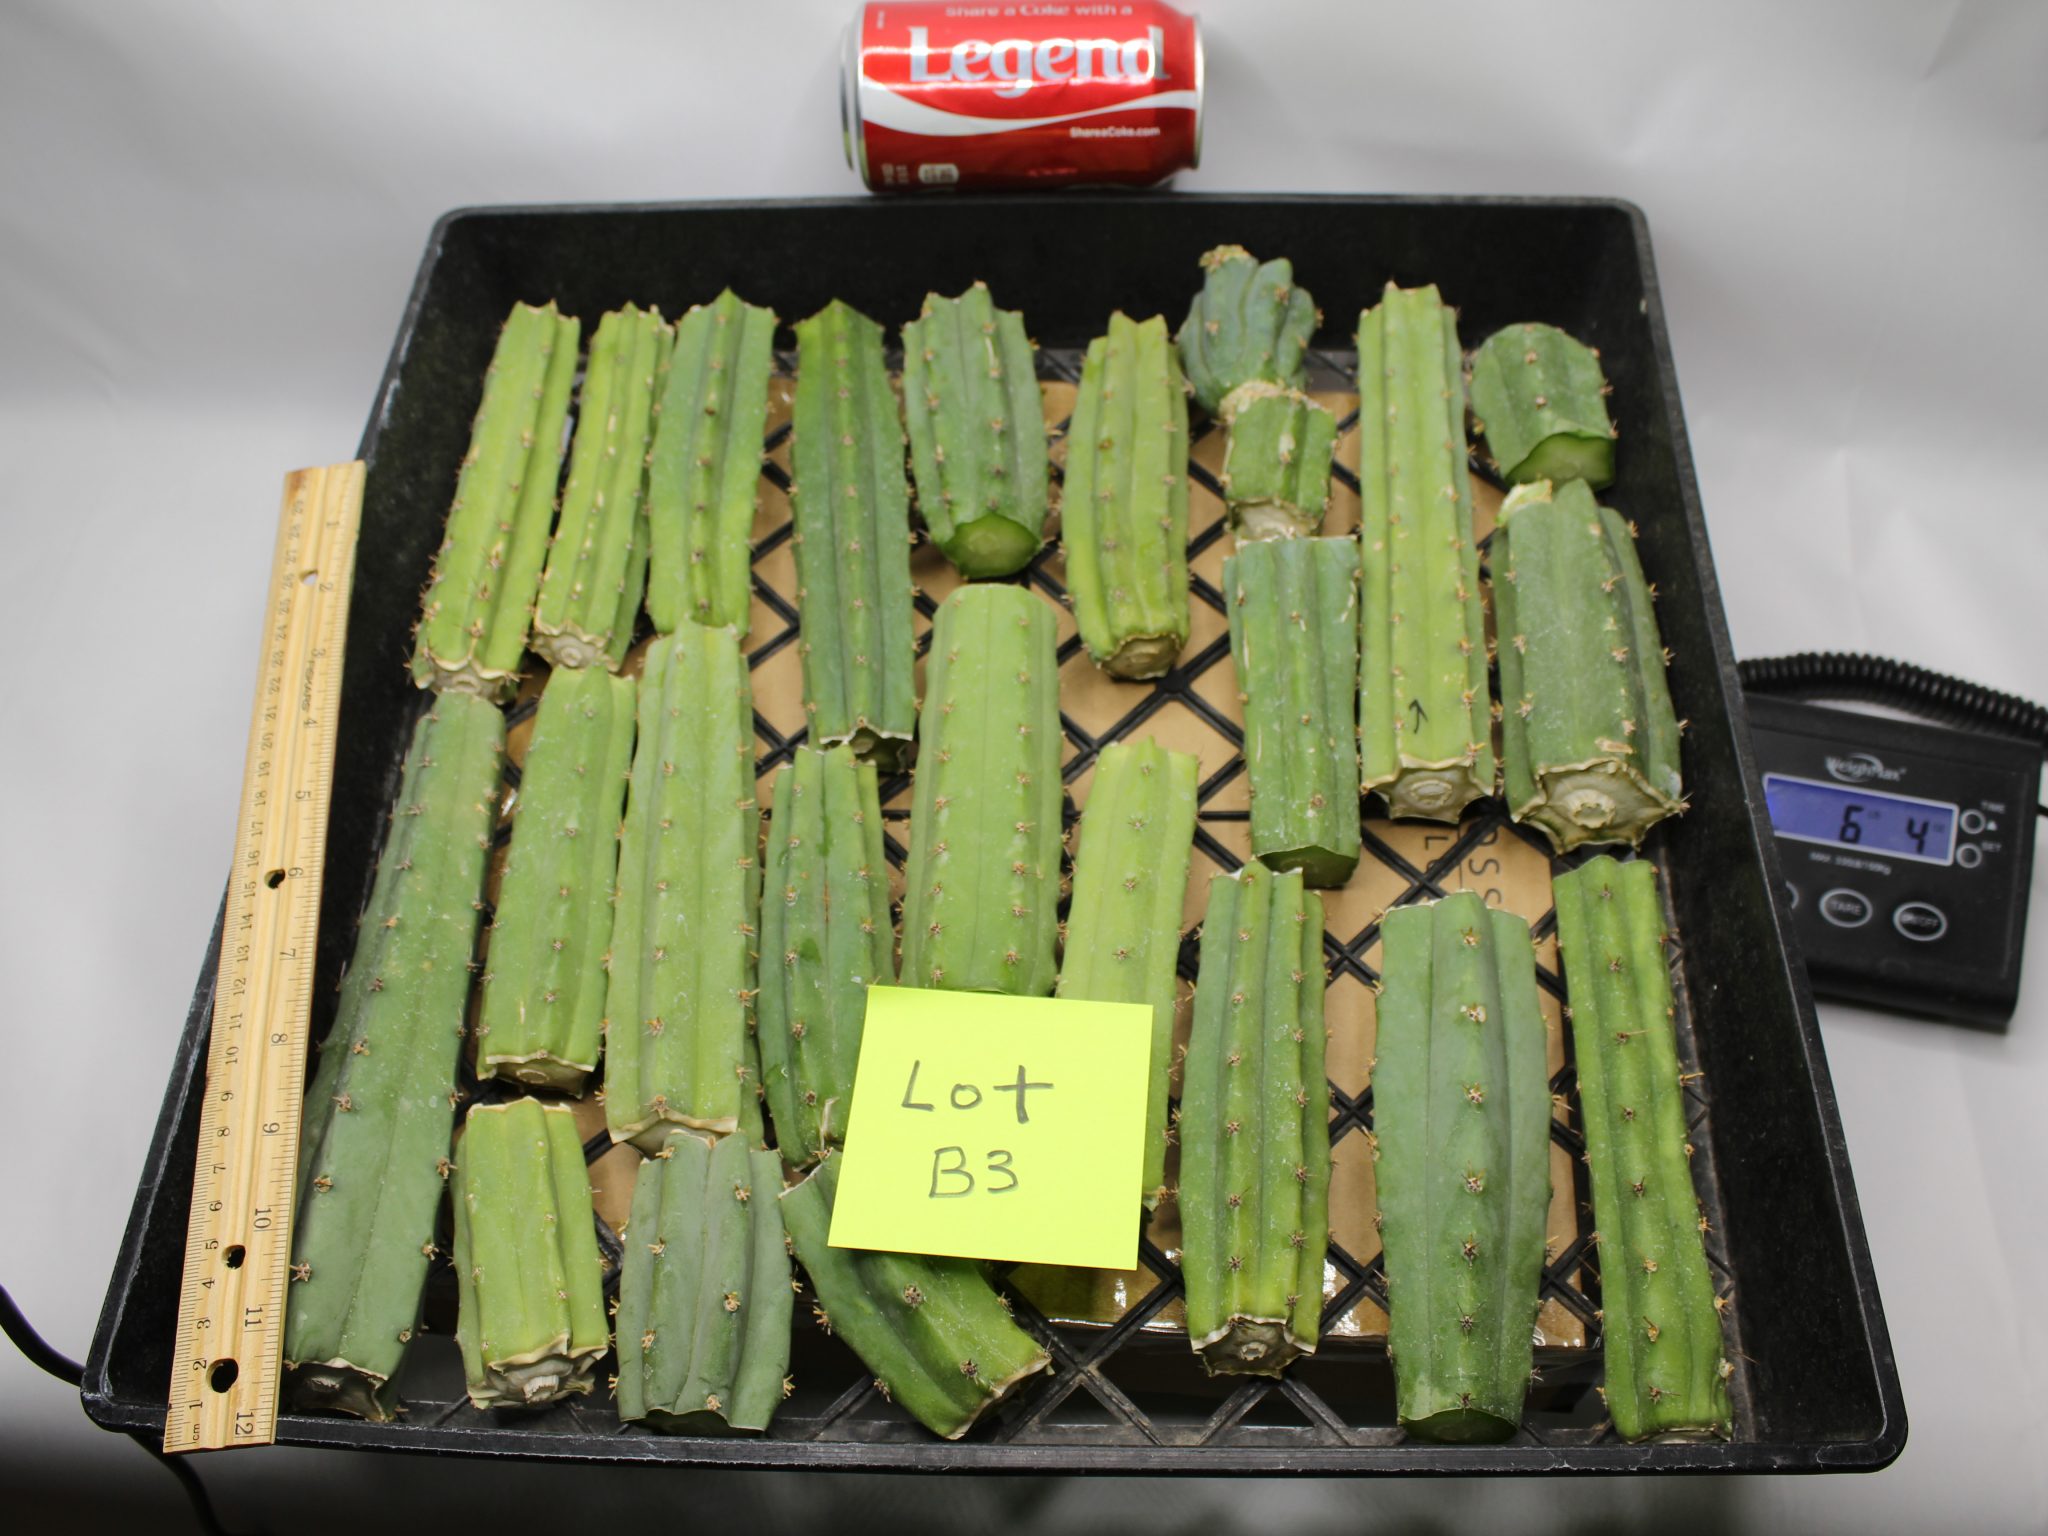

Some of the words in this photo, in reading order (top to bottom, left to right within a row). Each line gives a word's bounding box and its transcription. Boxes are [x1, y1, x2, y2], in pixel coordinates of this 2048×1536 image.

[1004, 8, 1016, 16] a
[1020, 5, 1070, 16] Coke
[1075, 5, 1116, 16] with
[1121, 7, 1133, 16] a
[907, 26, 1171, 98] Legend
[265, 705, 277, 722] 21
[304, 718, 318, 729] 4
[254, 790, 267, 807] 18
[296, 790, 311, 800] 5
[251, 821, 263, 837] 17
[1839, 805, 1864, 844] 6
[1906, 817, 1929, 854] 4
[247, 850, 260, 868] 16
[288, 867, 303, 877] 6
[244, 881, 256, 898] 15
[1830, 900, 1861, 915] TARE
[240, 913, 253, 930] 14
[237, 945, 249, 962] 13
[279, 948, 296, 958] 7
[233, 977, 246, 996] 12
[229, 1012, 242, 1030] 11
[271, 1033, 288, 1044] 8
[225, 1046, 239, 1065] 10
[221, 1091, 234, 1102] 9
[901, 1059, 1054, 1124] Lot
[217, 1127, 230, 1137] 8
[263, 1122, 280, 1134] 9
[213, 1165, 226, 1174] 7
[929, 1146, 1018, 1199] B3
[210, 1201, 223, 1212] 6
[254, 1208, 272, 1229] 10
[206, 1240, 219, 1250] 5
[202, 1278, 215, 1289] 4
[197, 1319, 211, 1329] 3
[245, 1306, 263, 1327] 11
[193, 1360, 207, 1371] 2
[189, 1401, 203, 1411] 1
[235, 1412, 254, 1435] 12
[193, 1423, 200, 1441] cm
